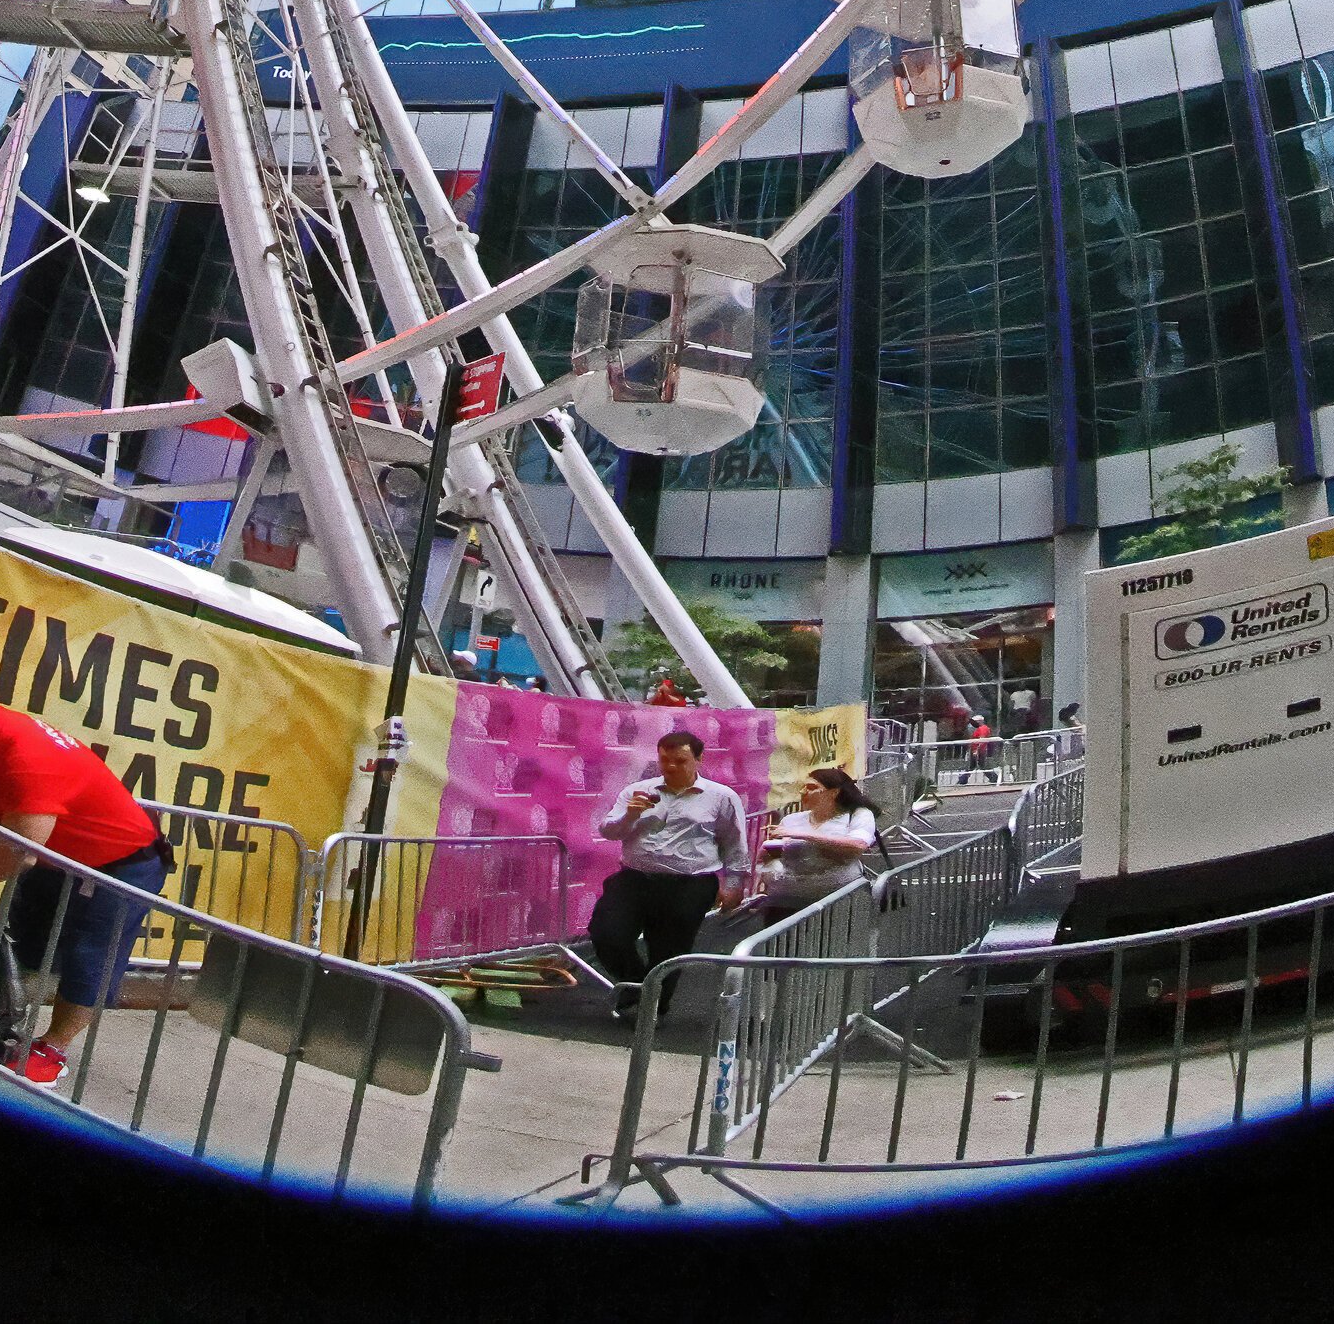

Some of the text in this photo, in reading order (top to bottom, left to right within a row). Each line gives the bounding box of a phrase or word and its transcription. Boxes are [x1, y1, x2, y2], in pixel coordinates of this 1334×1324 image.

[1231, 593, 1313, 626] United
[1231, 606, 1321, 642] Rentals
[1164, 638, 1324, 687] 800-UR-RENTS
[1157, 719, 1332, 769] UnitedRentals.com
